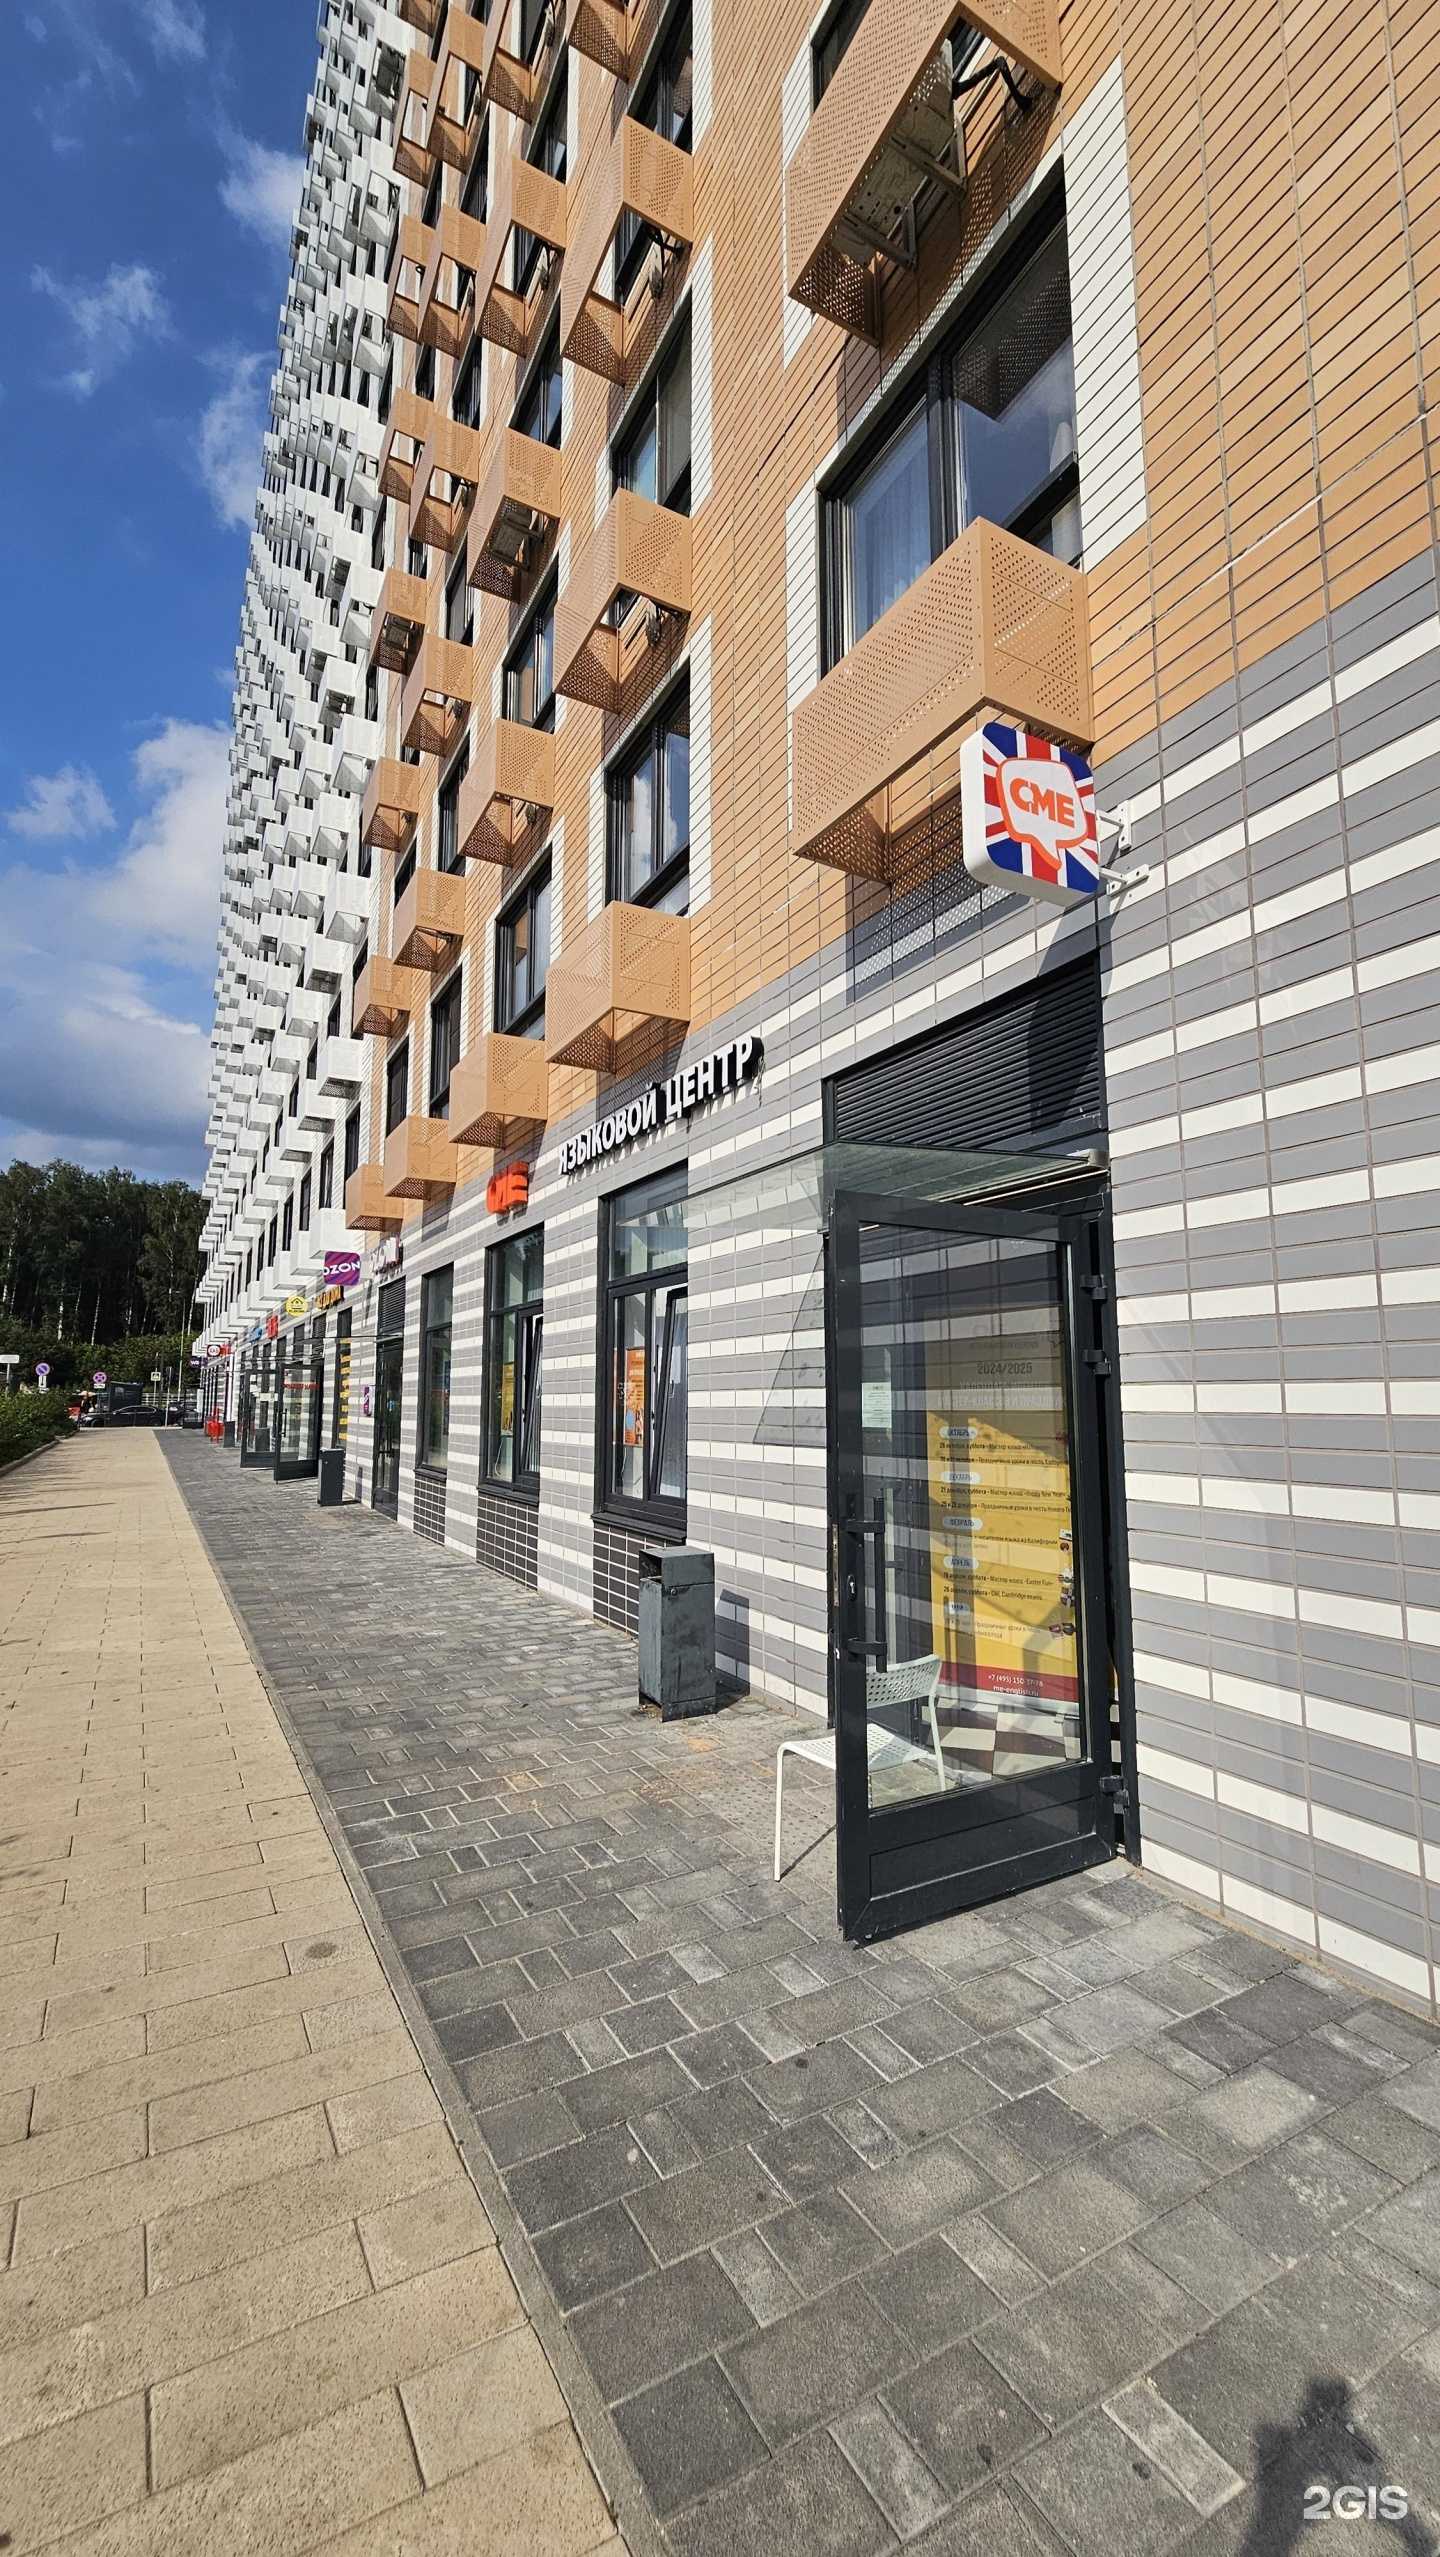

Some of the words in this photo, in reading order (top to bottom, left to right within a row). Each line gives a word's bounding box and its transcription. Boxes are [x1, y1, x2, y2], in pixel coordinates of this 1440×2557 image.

[1009, 777, 1075, 829] CME
[558, 1082, 657, 1176] ЯЗЫКОВОЙ
[664, 1034, 757, 1123] ЦЕНТР
[323, 1261, 360, 1275] OZON
[977, 1362, 1033, 1375] 2024/2025
